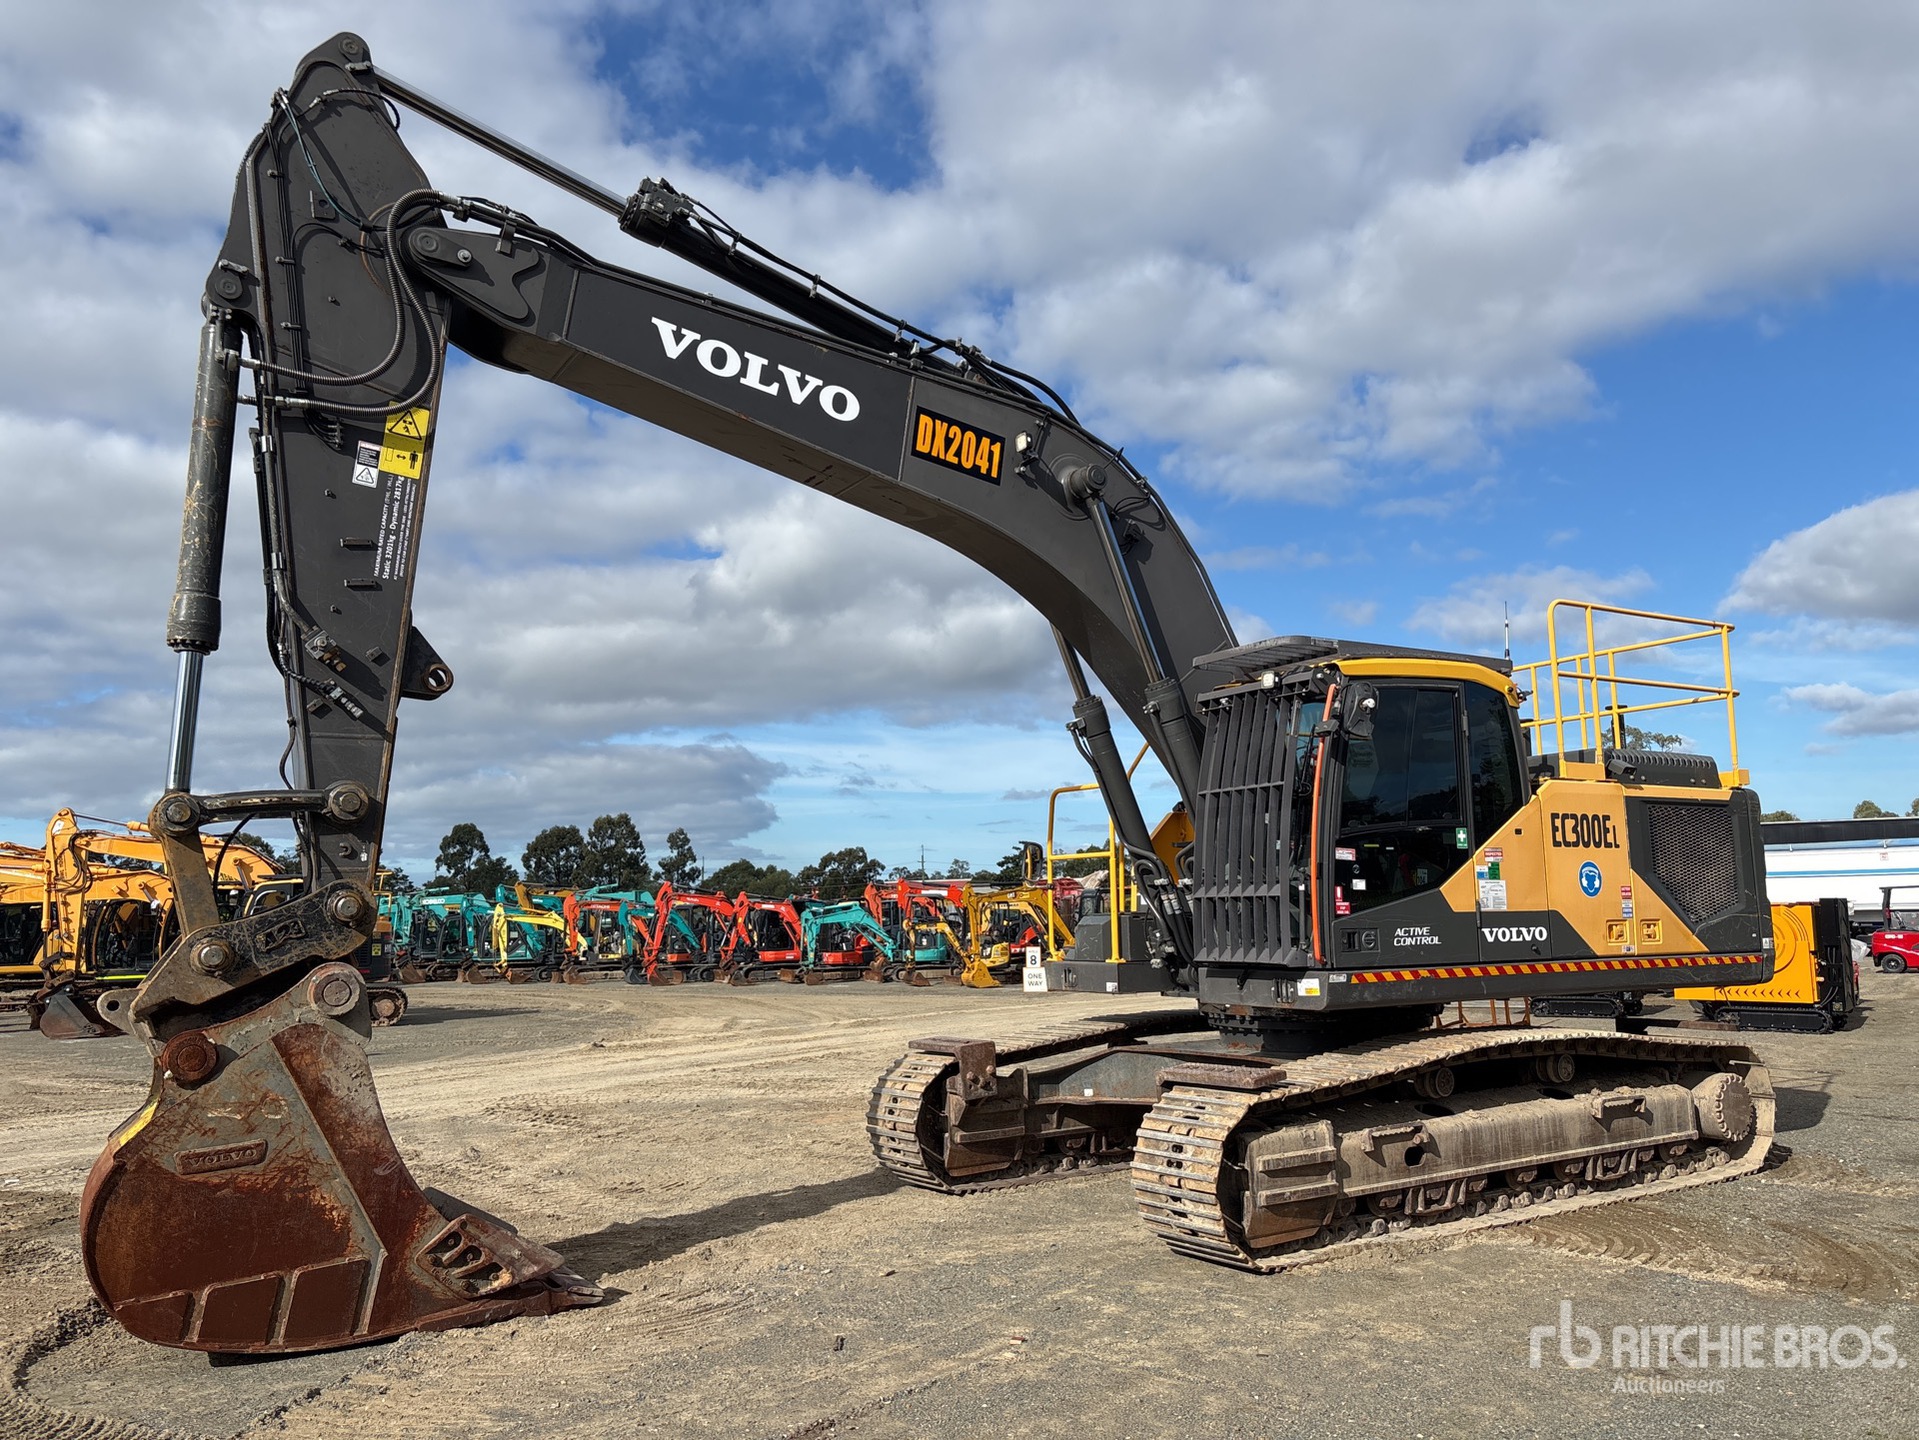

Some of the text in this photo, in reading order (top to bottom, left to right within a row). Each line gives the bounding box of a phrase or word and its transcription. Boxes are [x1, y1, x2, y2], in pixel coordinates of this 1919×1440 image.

[651, 316, 861, 422] VOLVO
[916, 413, 1001, 479] DX2041
[395, 475, 404, 500] 2817kg
[381, 504, 389, 529] CAPACITY
[390, 500, 399, 530] Dynamic
[385, 534, 396, 559] 3201kg
[382, 560, 391, 579] Static
[1550, 812, 1620, 849] EC300EL
[1394, 926, 1430, 936] ACTIVE
[1394, 936, 1442, 946] CONTROL
[1481, 926, 1548, 942] VOLVO
[1030, 954, 1037, 966] 8
[189, 1148, 257, 1167] VOLVO
